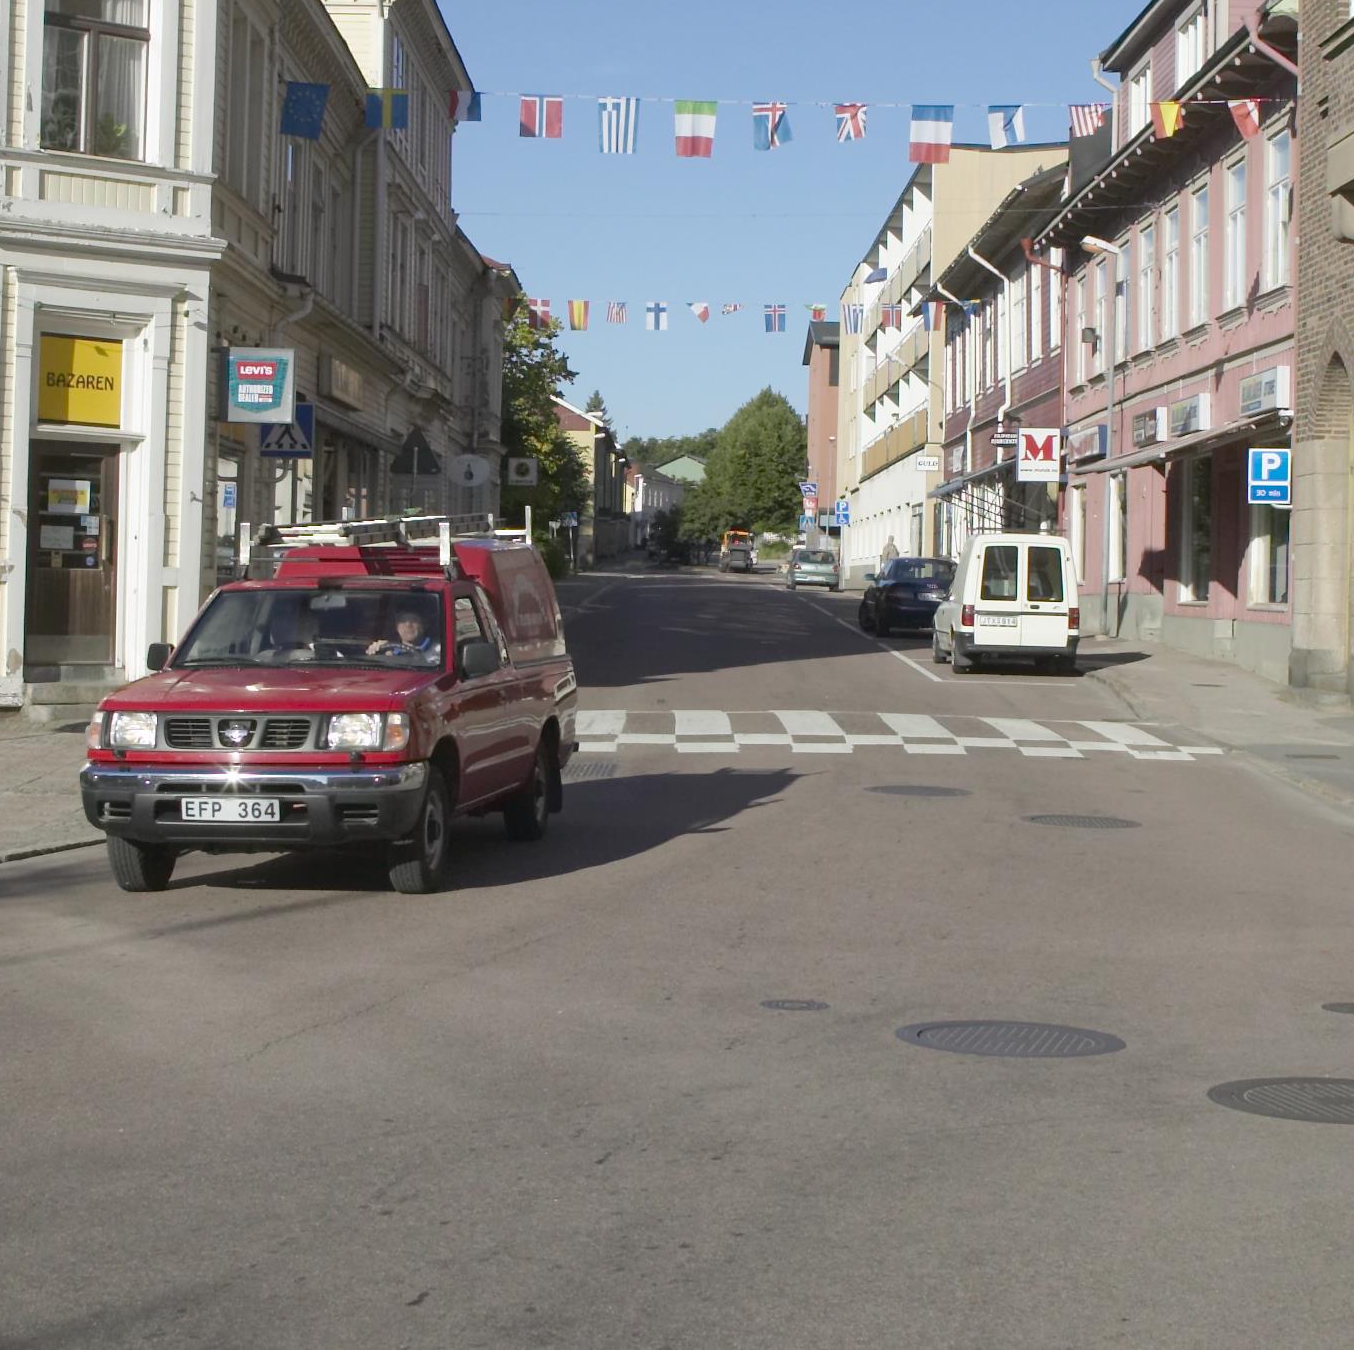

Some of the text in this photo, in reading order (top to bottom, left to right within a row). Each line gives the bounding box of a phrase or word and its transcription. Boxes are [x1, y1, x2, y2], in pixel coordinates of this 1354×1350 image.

[47, 372, 114, 391] BAZAREN
[1021, 434, 1058, 461] M
[1261, 453, 1281, 481] P
[1256, 489, 1266, 497] 30
[185, 801, 276, 819] EFP 364
